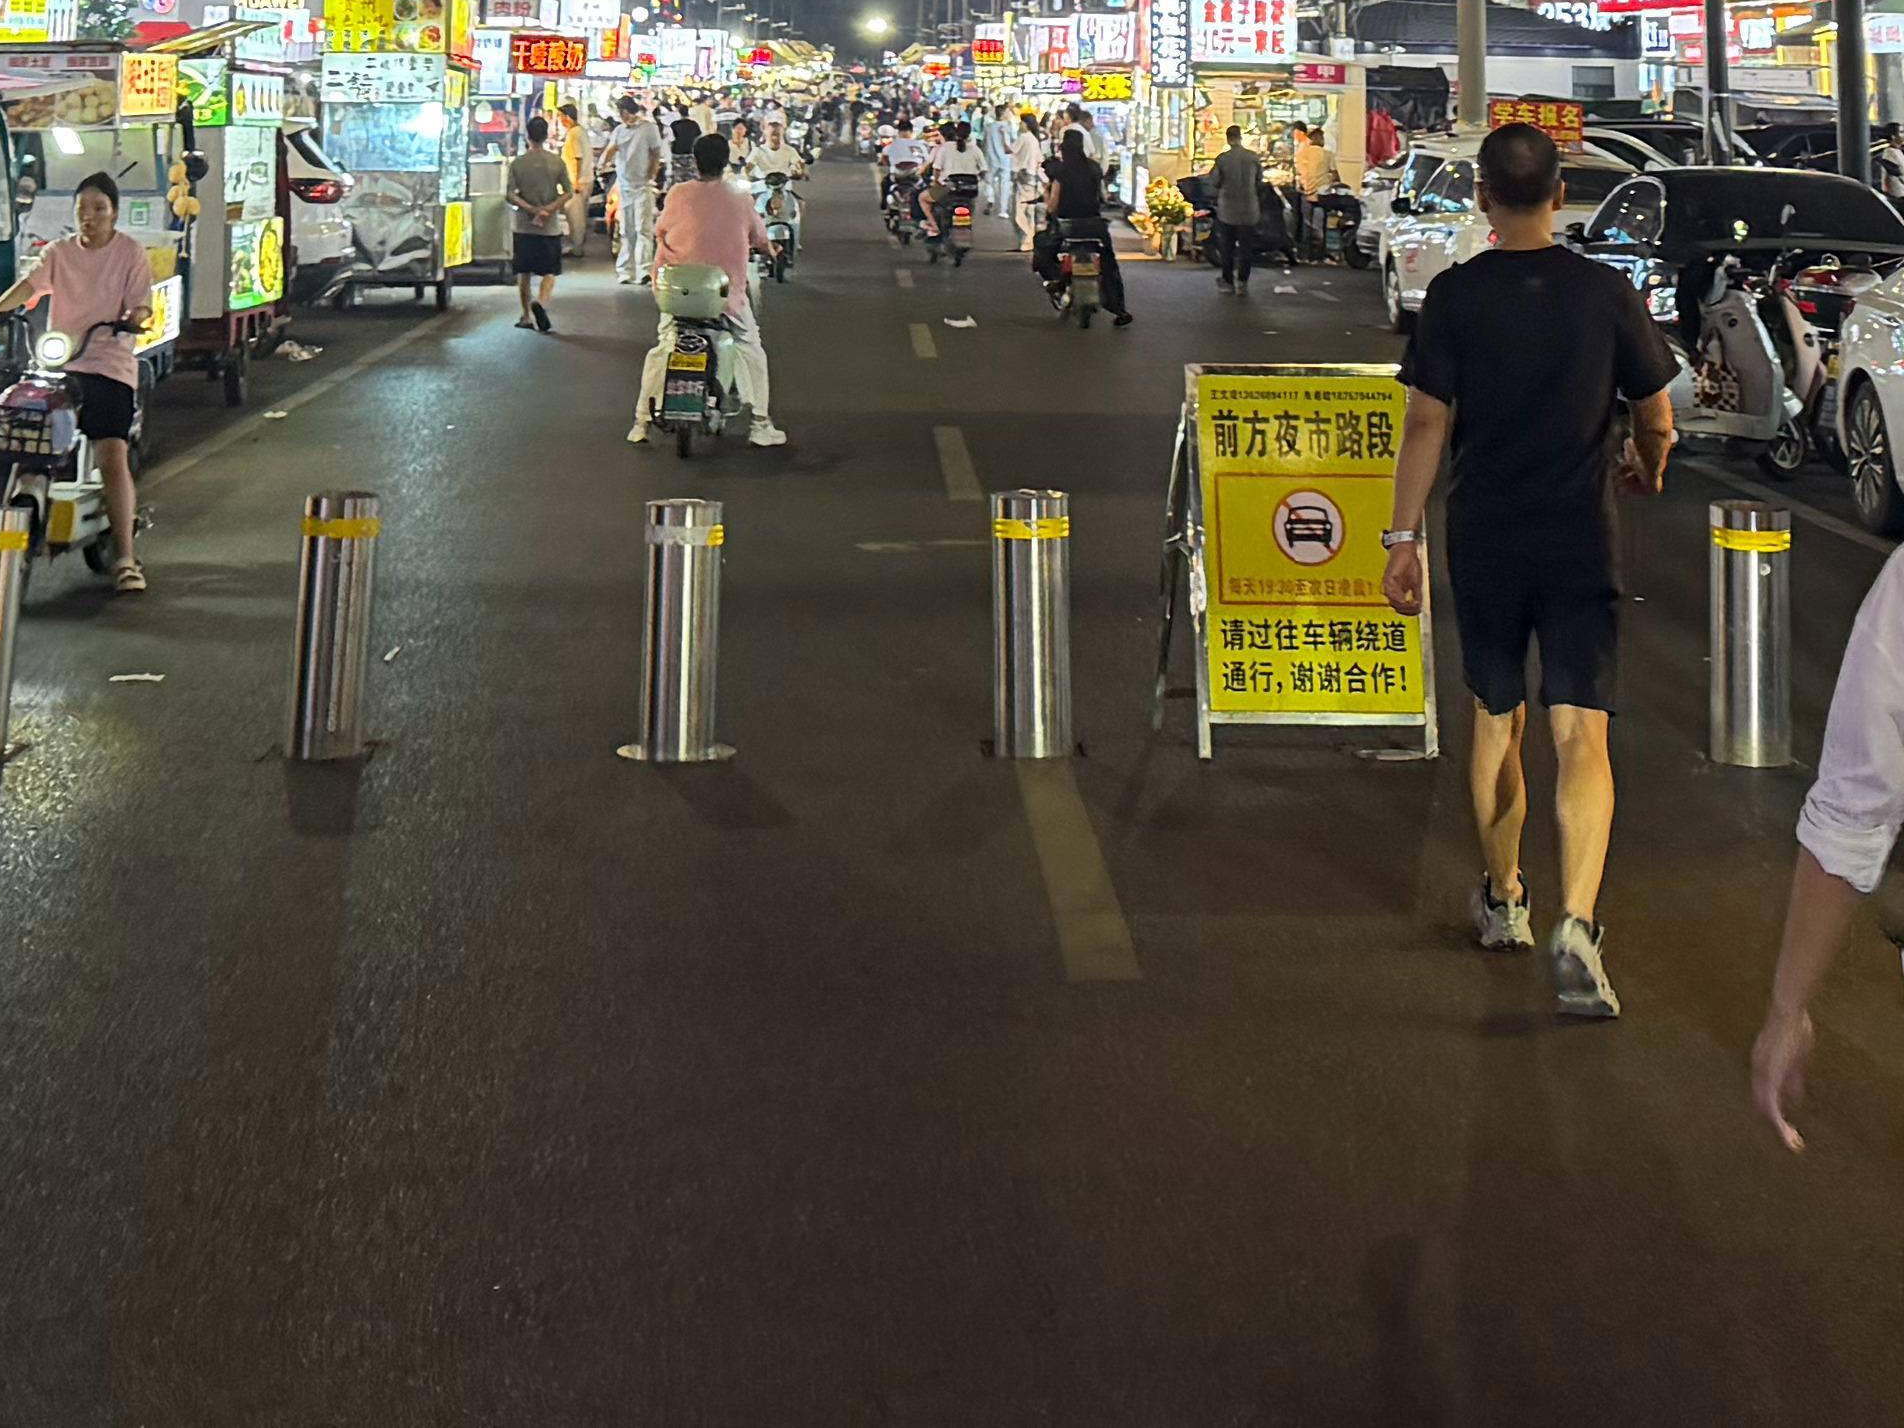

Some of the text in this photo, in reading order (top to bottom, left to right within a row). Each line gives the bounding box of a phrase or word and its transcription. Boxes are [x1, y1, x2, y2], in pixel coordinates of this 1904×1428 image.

[1211, 409, 1395, 459] 前方夜市路段
[1221, 618, 1408, 653] 请过往车辆绕道
